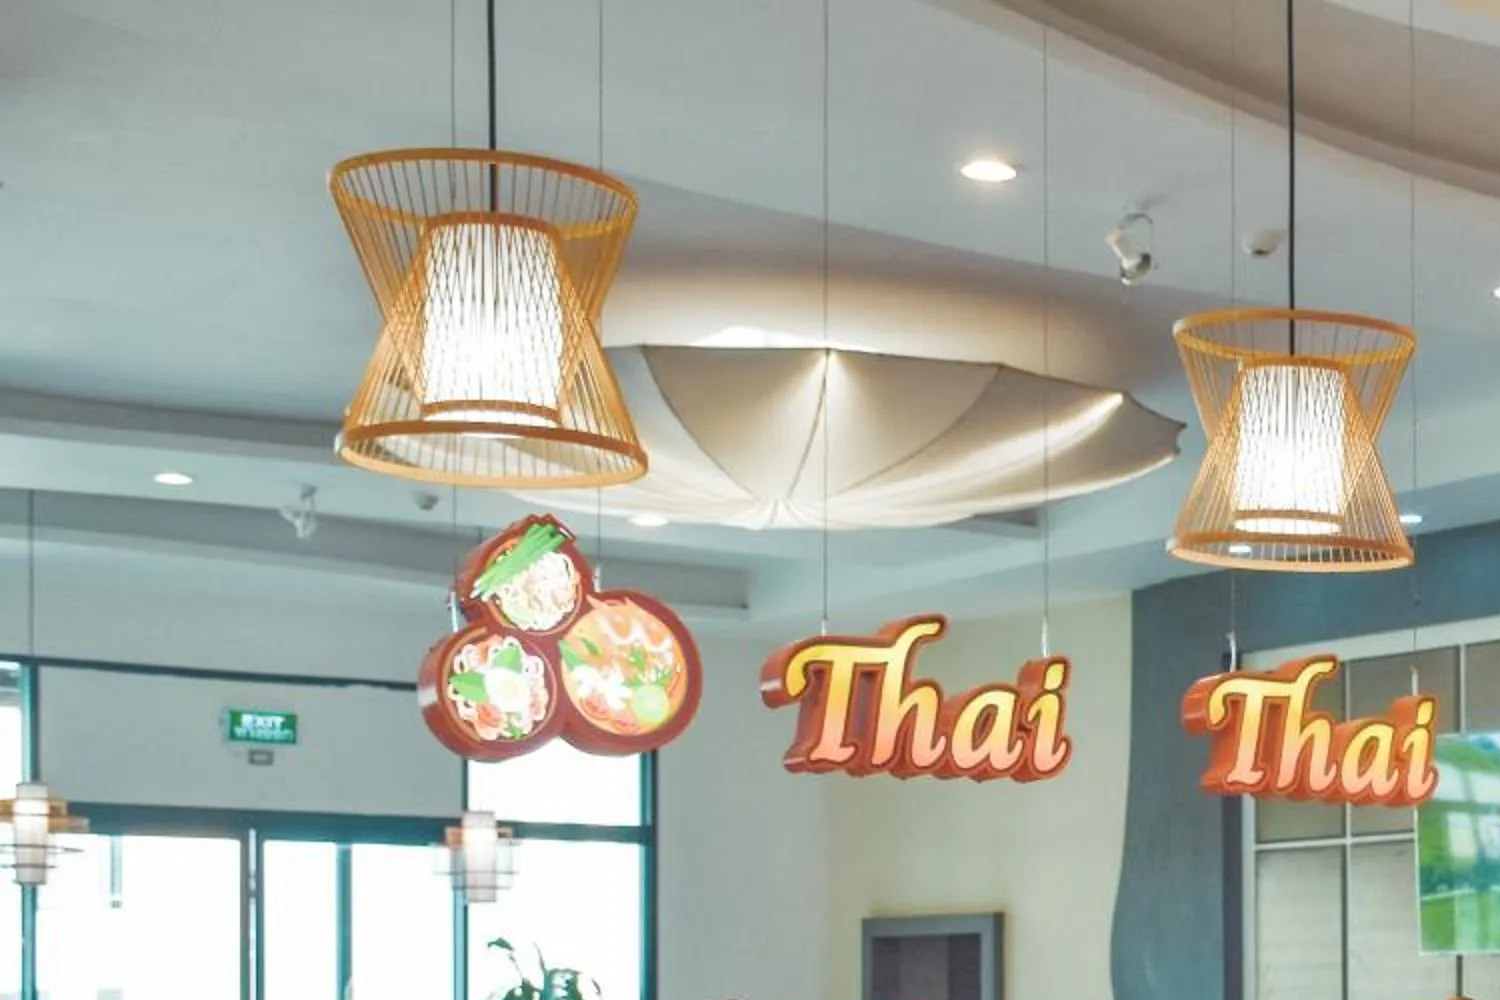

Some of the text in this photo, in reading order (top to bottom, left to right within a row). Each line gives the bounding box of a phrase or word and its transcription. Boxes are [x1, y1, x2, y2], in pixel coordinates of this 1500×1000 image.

[240, 713, 286, 728] EXIT
[784, 617, 1070, 771] Thai
[1206, 657, 1438, 801] Thai
